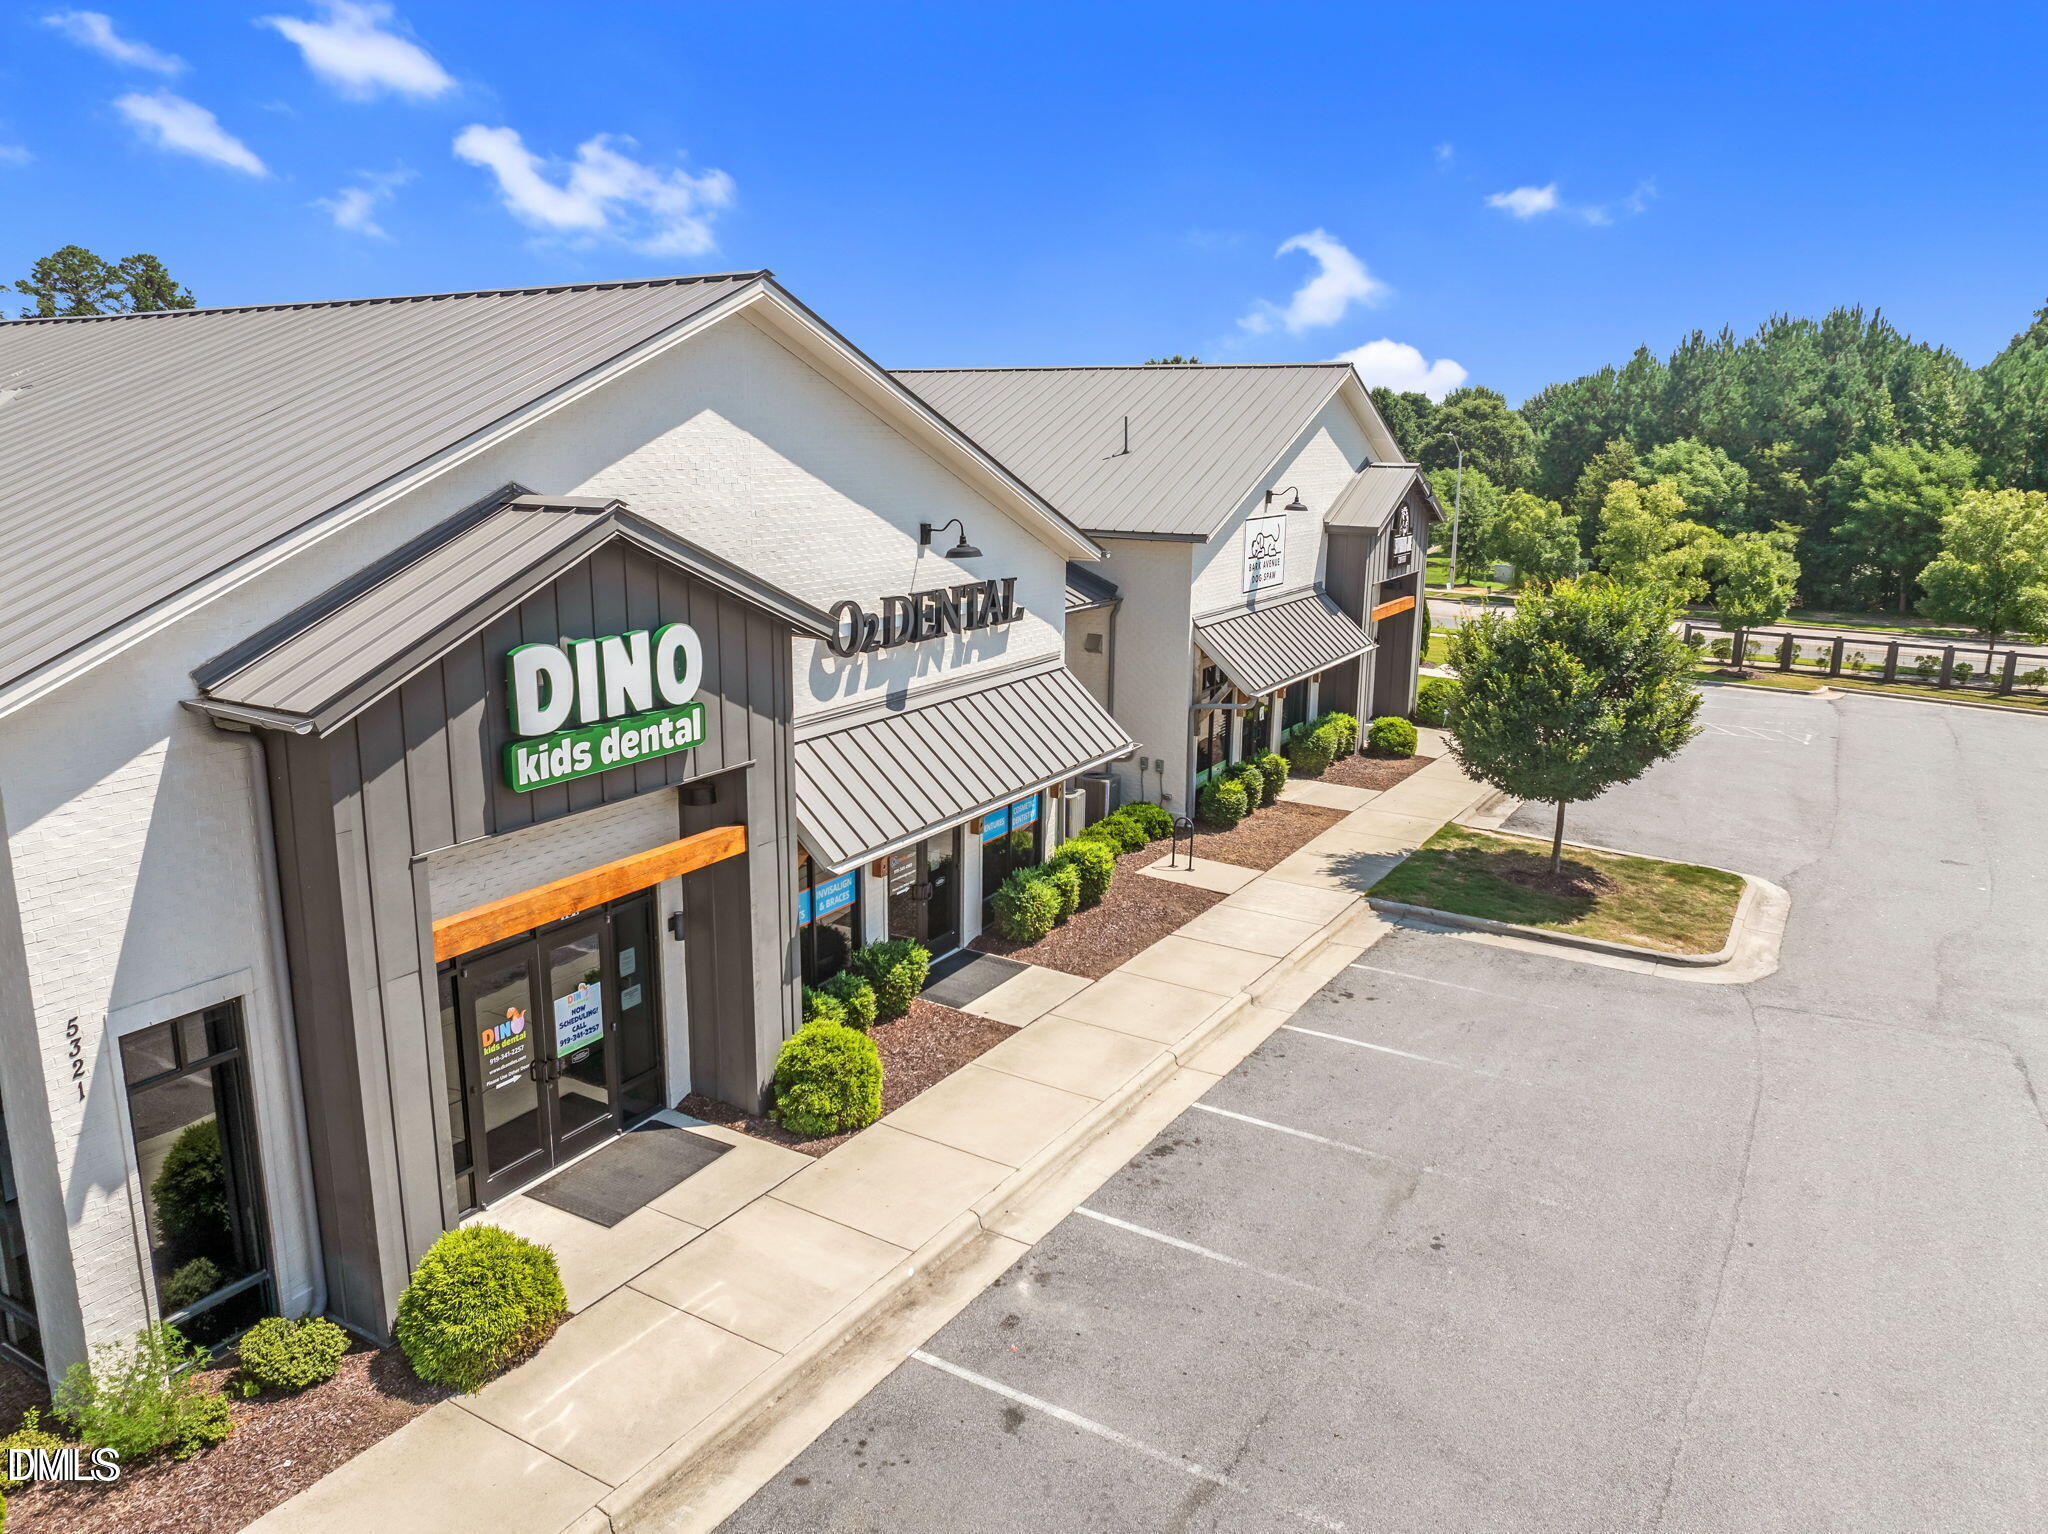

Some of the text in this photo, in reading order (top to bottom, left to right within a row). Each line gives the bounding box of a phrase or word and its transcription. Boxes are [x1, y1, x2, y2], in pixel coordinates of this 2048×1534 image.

[1248, 558, 1280, 572] BARK AVENUE
[1251, 571, 1276, 584] DOG SPAW
[506, 622, 703, 736] DINO
[517, 708, 702, 786] kids dental
[984, 817, 1005, 832] ENTURES
[819, 890, 850, 911] & BRACES
[559, 1007, 599, 1029] SCHEDULING!
[571, 1004, 586, 1015] NOW
[559, 1024, 600, 1047] 919-341-2257
[572, 1022, 587, 1032] CALL
[483, 1031, 527, 1056] kids dental
[489, 1045, 525, 1065] 919-341-2257
